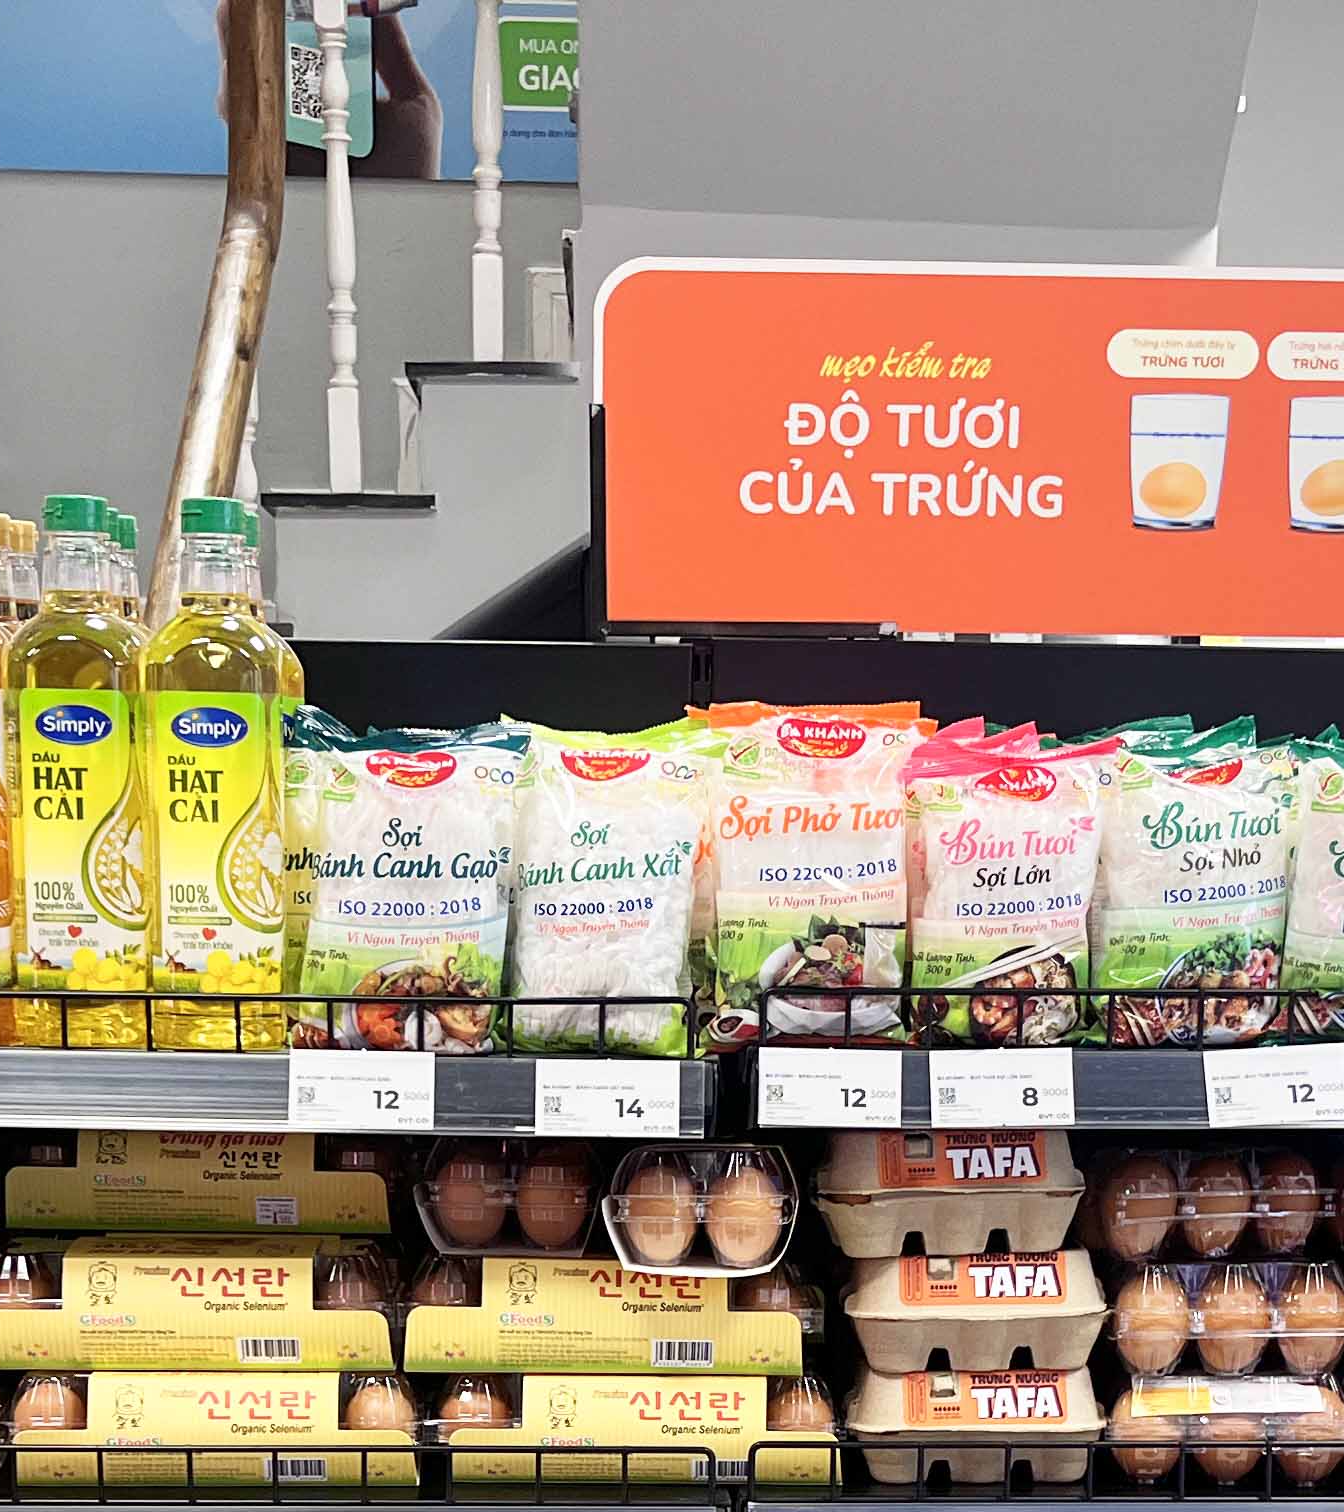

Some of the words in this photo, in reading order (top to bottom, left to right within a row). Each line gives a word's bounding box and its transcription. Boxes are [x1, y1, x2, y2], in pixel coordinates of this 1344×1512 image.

[519, 38, 557, 54] MUA
[819, 353, 876, 384] mẹo
[949, 353, 992, 379] tra
[784, 389, 870, 459] ĐỘ
[886, 397, 1021, 449] TƯƠI
[739, 458, 856, 515] CỦA
[870, 459, 1064, 519] TRỨNG
[32, 767, 88, 795] HẠT
[720, 796, 771, 840] Sợi
[782, 800, 841, 833] Phở
[381, 817, 422, 852] Sợi
[570, 820, 610, 850] Sợi
[939, 818, 1015, 865] Bún
[1023, 828, 1078, 857] Tươi
[372, 850, 443, 879] Canh
[451, 852, 499, 885] Gạo
[1221, 842, 1262, 868] Nhỏ
[570, 856, 635, 883] Canh
[973, 866, 1009, 892] Sợi
[1013, 865, 1052, 887] Lớn
[338, 899, 367, 916] ISO
[371, 901, 425, 917] 22000
[439, 897, 482, 915] 2018
[533, 902, 557, 917] ISO
[560, 901, 605, 917] 22000
[617, 897, 654, 913] 2018
[373, 1089, 400, 1110] 12
[840, 1087, 868, 1108] 12
[1022, 1087, 1039, 1107] 8
[1287, 1084, 1315, 1104] 12
[615, 1097, 645, 1119] 14
[945, 1146, 1042, 1179] TAFA
[170, 1265, 292, 1297] 신선란
[968, 1264, 1064, 1298] TAFA
[203, 1300, 241, 1313] Organic
